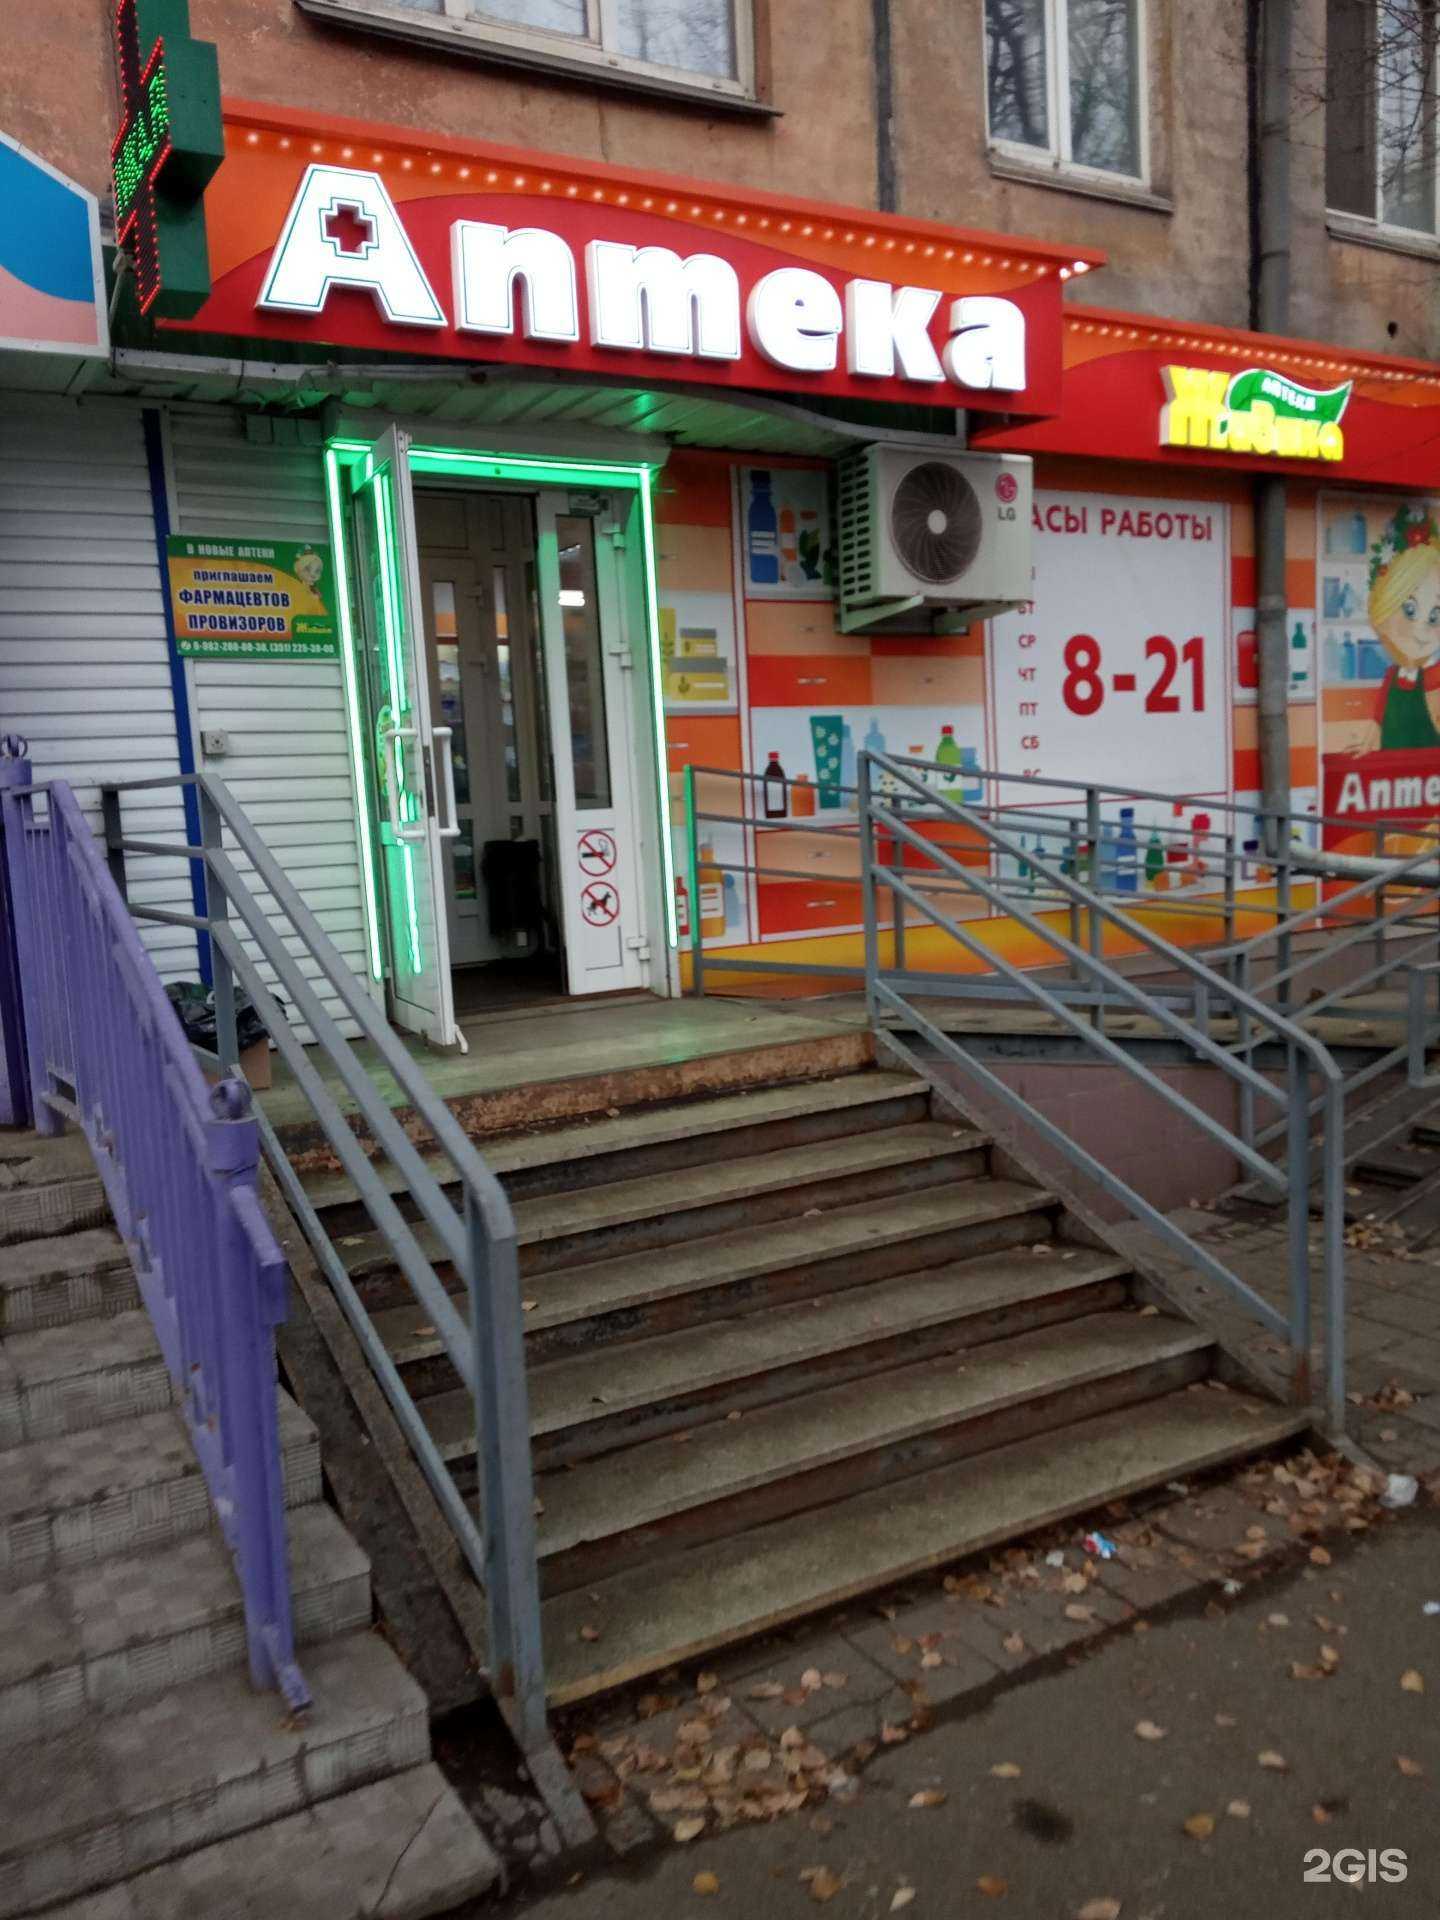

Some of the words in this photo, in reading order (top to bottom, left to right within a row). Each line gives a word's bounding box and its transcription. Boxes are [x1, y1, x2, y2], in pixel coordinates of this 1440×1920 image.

[254, 163, 1026, 391] Аптека
[997, 507, 1017, 522] LG
[1032, 502, 1087, 534] АСЫ
[1101, 508, 1212, 541] РАБОТЫ
[197, 544, 235, 557] НОВЫЕ
[193, 570, 274, 584] приглашаем
[179, 588, 290, 608] ФАРМАЦЕВТОВ
[187, 613, 286, 632] ПРОВИЗОРОВ
[1018, 634, 1036, 649] СР
[1018, 667, 1037, 682] ЧТ
[1062, 633, 1206, 717] 8-21
[1018, 702, 1039, 716] ПТ
[1020, 736, 1040, 750] СБ
